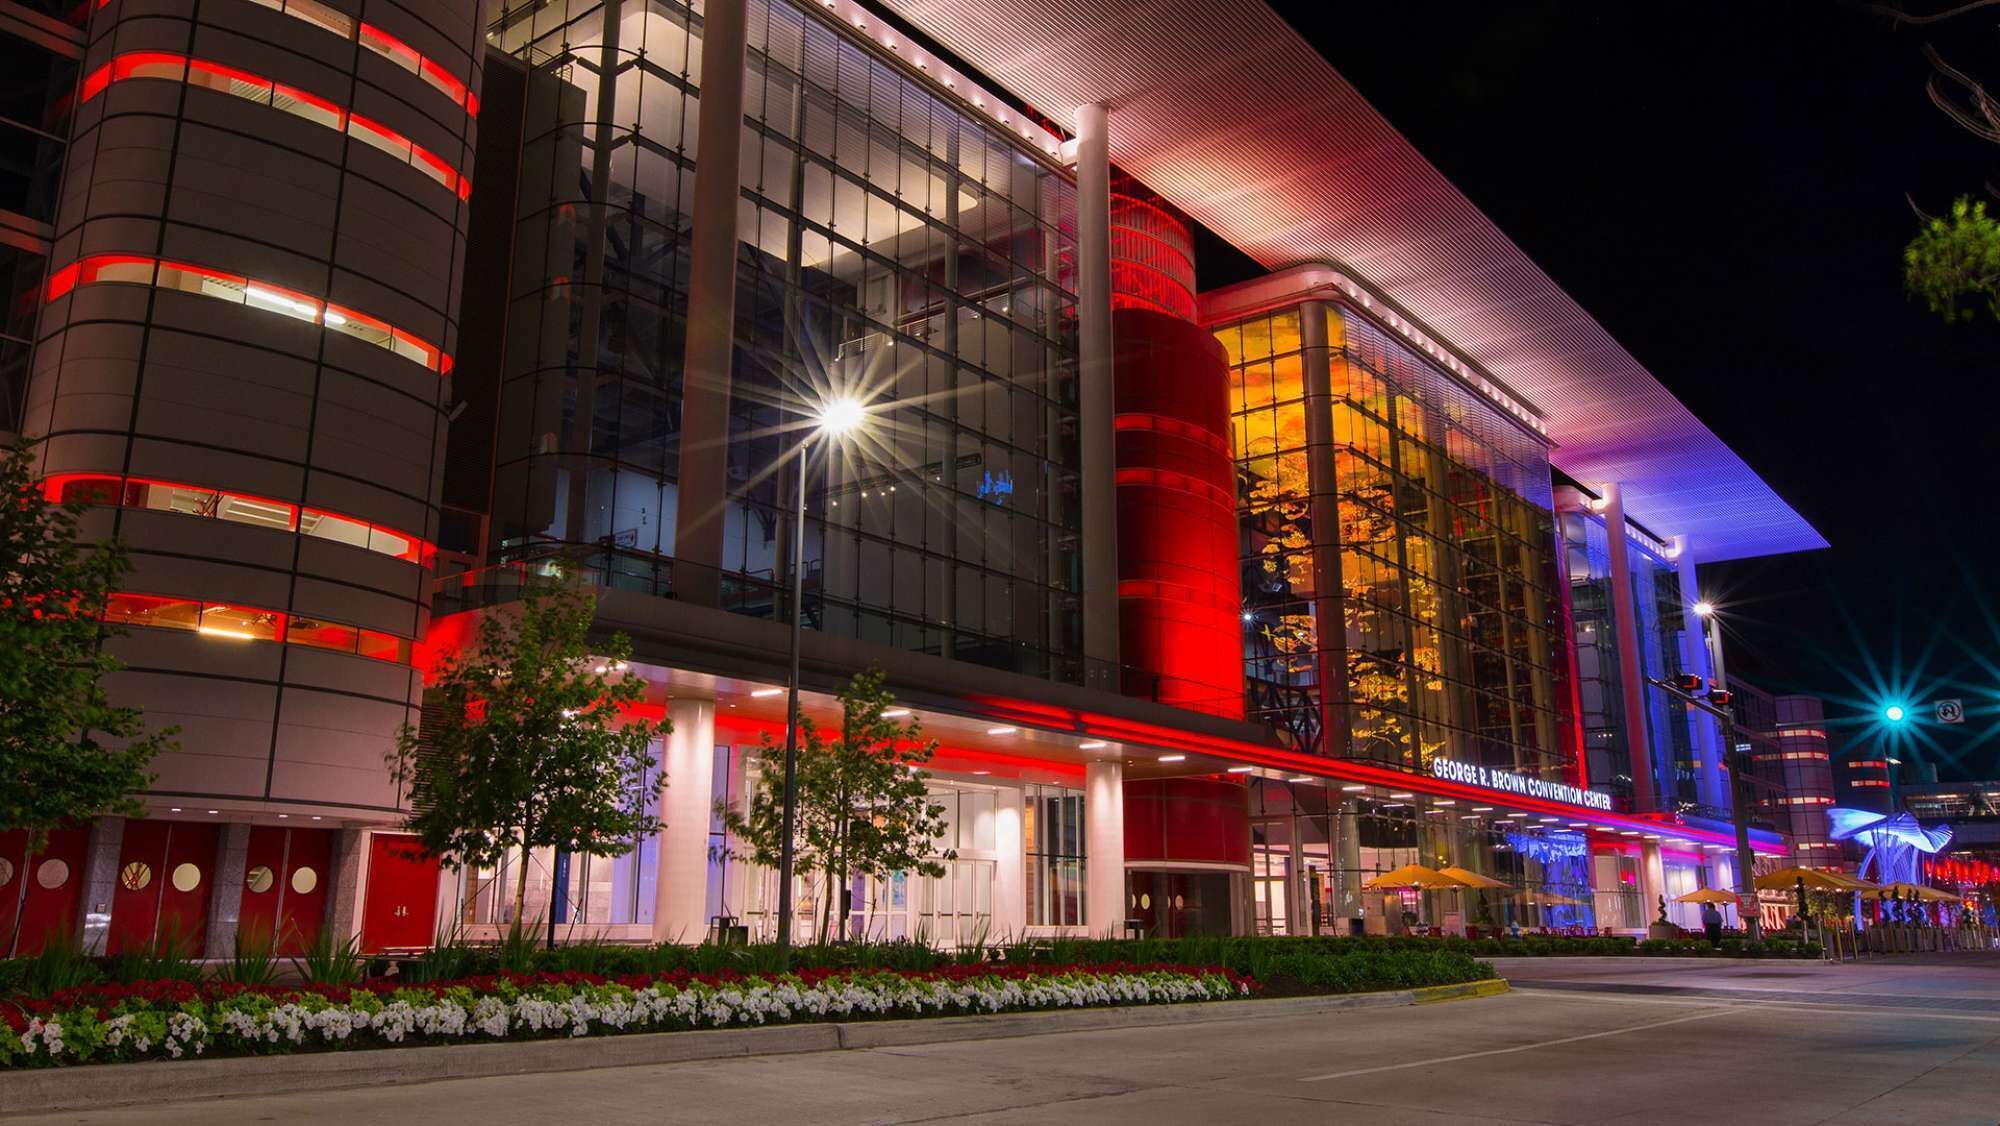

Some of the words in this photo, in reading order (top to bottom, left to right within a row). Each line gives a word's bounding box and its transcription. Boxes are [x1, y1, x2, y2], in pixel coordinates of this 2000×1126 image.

[1434, 757, 1477, 784] GEORGE
[1479, 767, 1490, 787] R.
[1492, 769, 1526, 794] BROWN
[1528, 778, 1582, 805] CONVENTION
[1584, 790, 1611, 810] CENTER
